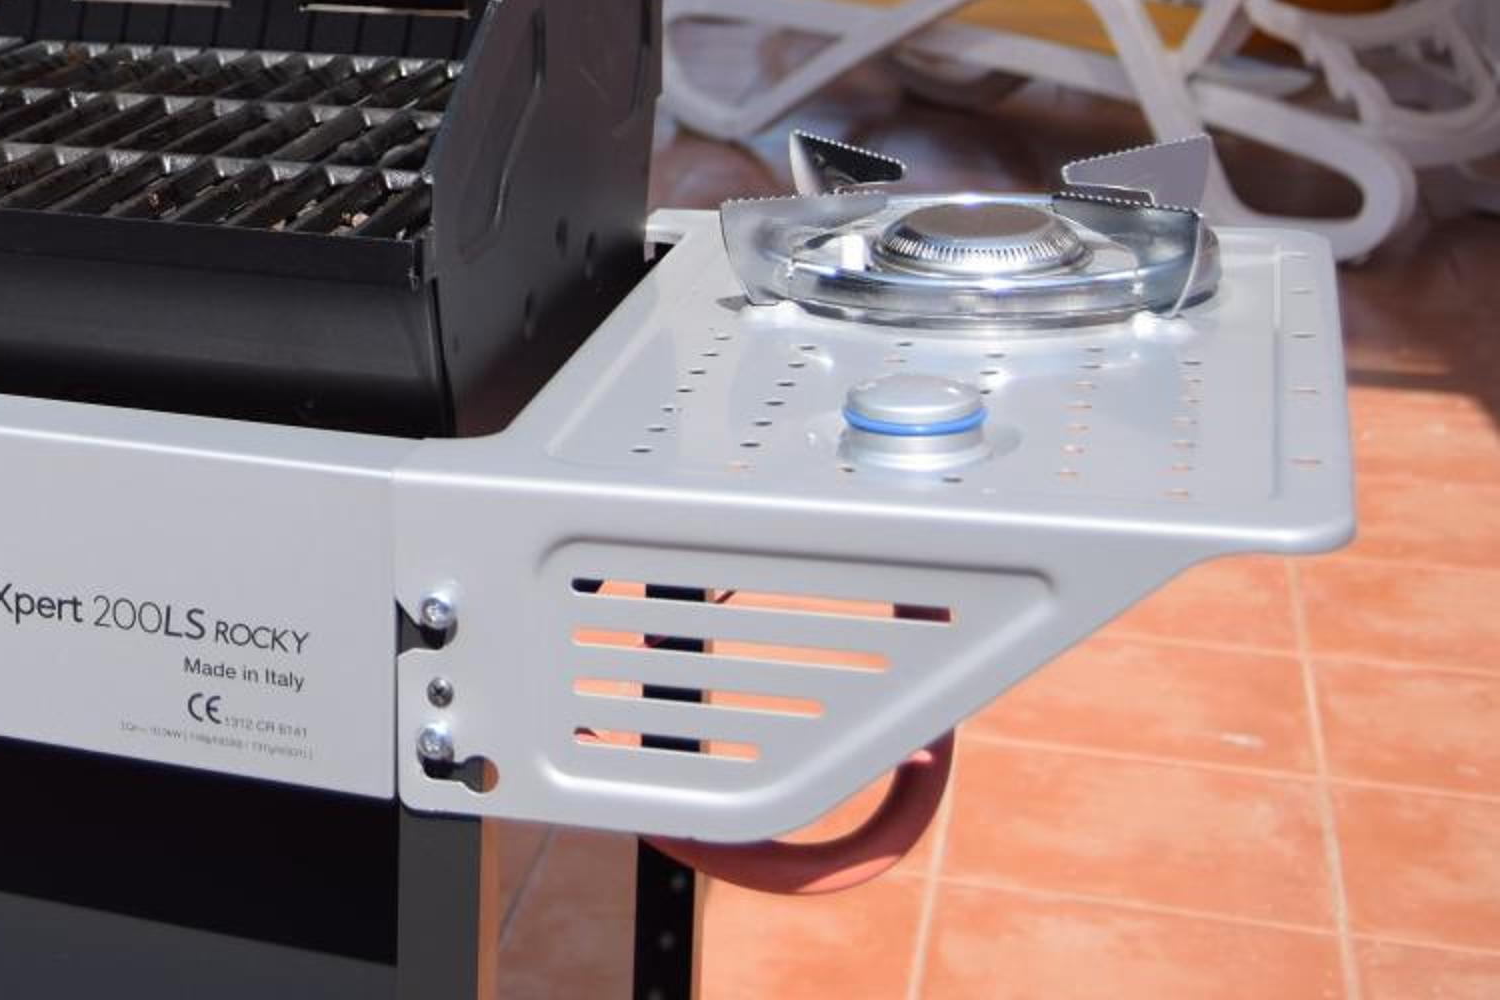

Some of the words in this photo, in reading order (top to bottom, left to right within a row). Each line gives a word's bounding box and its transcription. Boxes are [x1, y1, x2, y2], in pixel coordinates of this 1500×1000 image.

[93, 595, 205, 640] 200LS
[215, 621, 309, 654] ROCKY
[184, 656, 237, 680] Made
[242, 667, 260, 683] in
[264, 670, 304, 692] Italy
